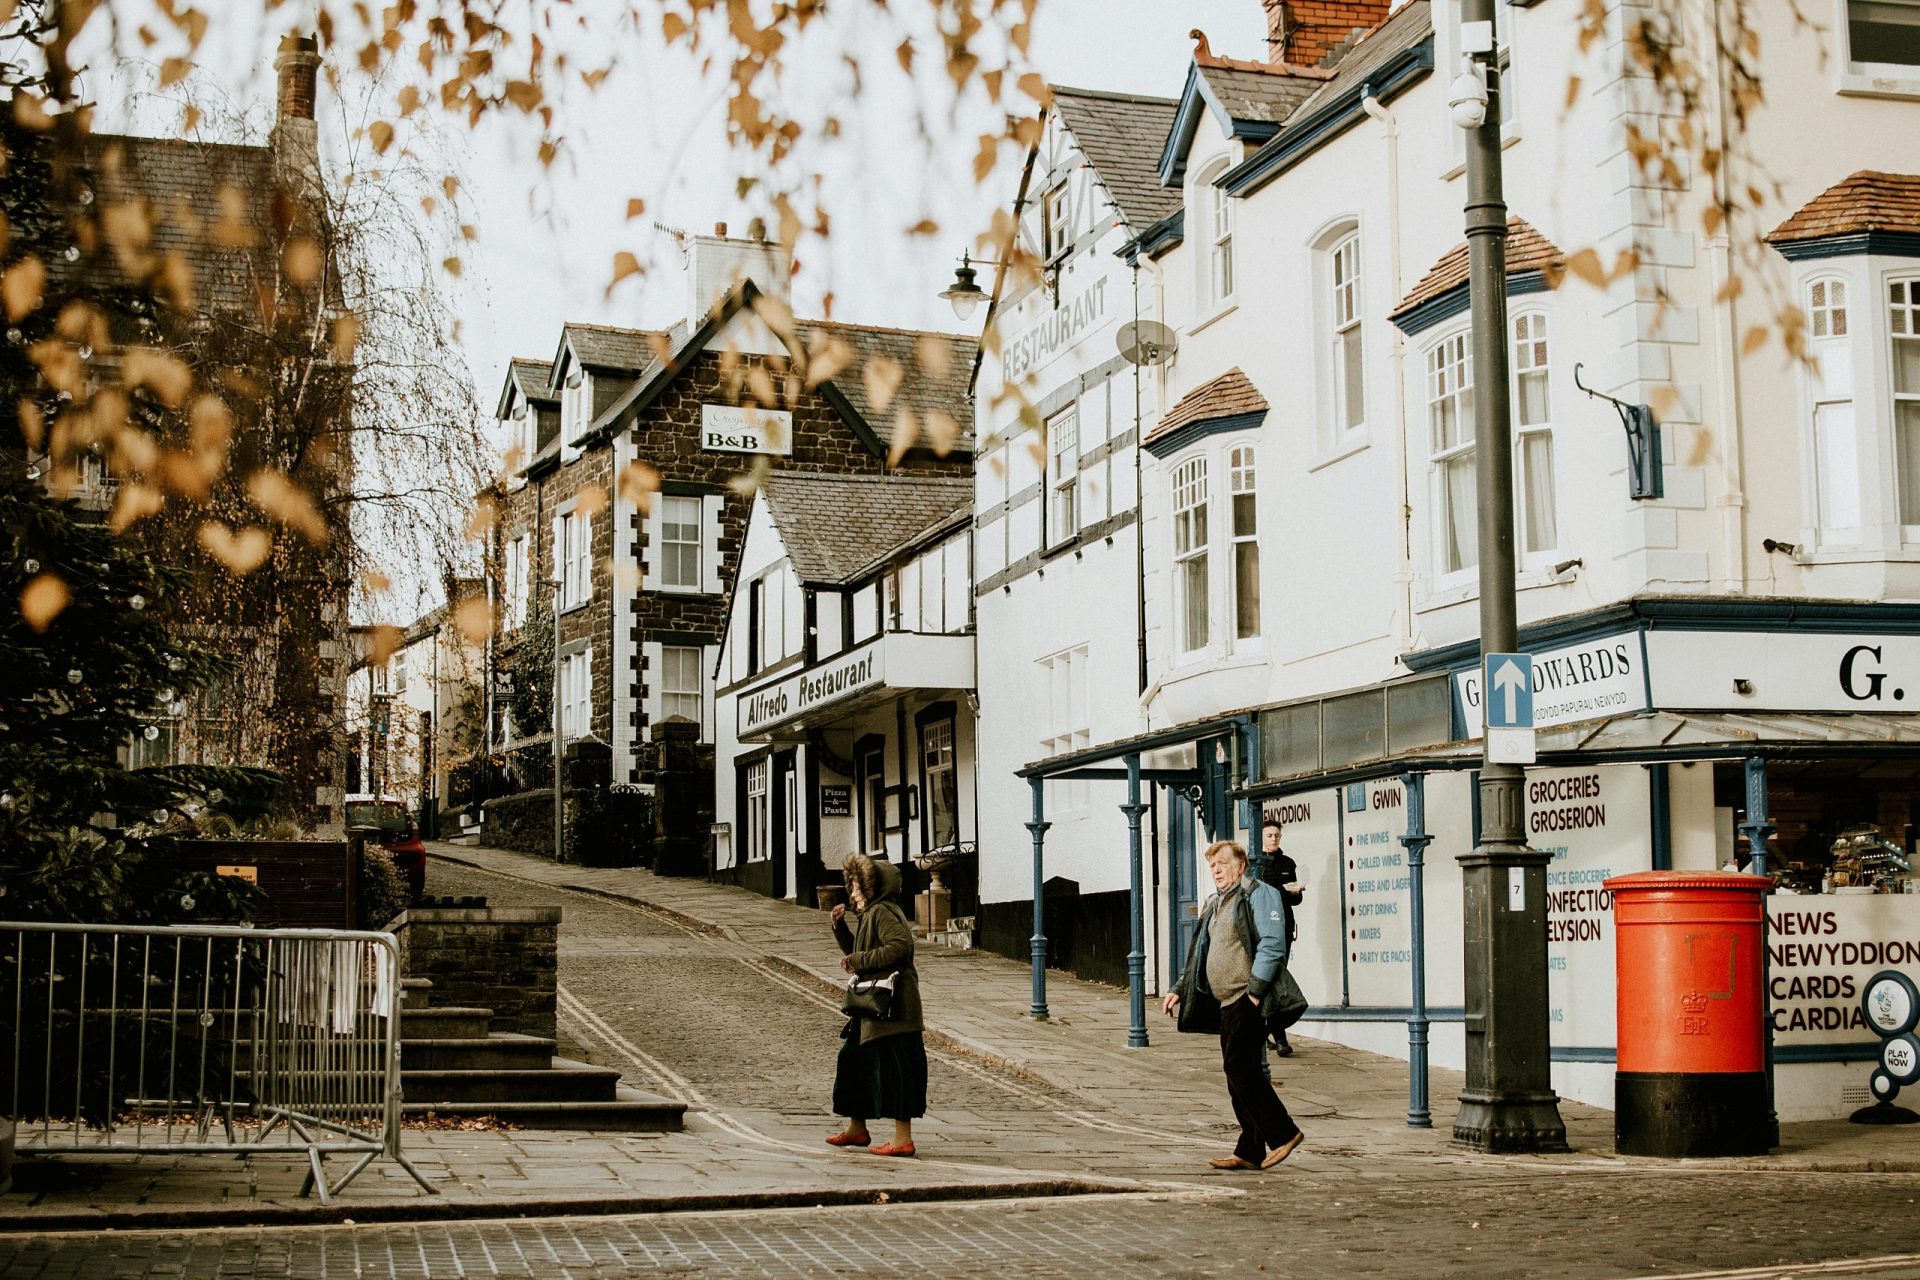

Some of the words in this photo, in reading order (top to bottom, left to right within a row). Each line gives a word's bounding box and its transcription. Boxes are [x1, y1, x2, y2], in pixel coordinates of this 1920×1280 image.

[1002, 275, 1108, 382] RESTAURANT
[707, 432, 758, 449] B&B
[1533, 644, 1630, 693] DWARDS
[1839, 645, 1905, 701] G.
[495, 683, 515, 694] B&B
[747, 687, 788, 727] Alfredo
[798, 649, 873, 707] Restaurant
[1560, 700, 1593, 715] PAPURAU
[1594, 692, 1627, 708] NEWYDD
[824, 788, 847, 796] Pizza
[1373, 787, 1401, 810] GWIN
[1529, 774, 1600, 804] GROCERIES
[824, 806, 848, 814] Pasta
[1264, 802, 1311, 824] EWYDDION
[1530, 804, 1606, 833] GROSERION
[1357, 834, 1369, 846] FINE
[1370, 831, 1389, 845] WINES
[1357, 856, 1380, 870] CHILLED
[1382, 854, 1402, 867] WINES
[1358, 880, 1375, 893] BEERS
[1376, 879, 1390, 891] AND
[1392, 877, 1410, 890] LAGER
[1547, 871, 1566, 886] ENCE
[1568, 869, 1611, 885] GROCERIES
[1513, 884, 1520, 895] 7
[1359, 904, 1374, 917] SOFT
[1375, 902, 1397, 915] DRINKS
[1547, 919, 1601, 942] ELYSION
[1767, 912, 1838, 936] NEWS
[1359, 928, 1381, 940] MIXERS
[1359, 951, 1378, 963] PARTY
[1380, 950, 1390, 963] ICE
[1391, 950, 1410, 962] PACKS
[1768, 941, 1920, 967] NEWYDDION
[1770, 975, 1856, 1000] CARDS
[1773, 1006, 1868, 1032] CARDIA
[1888, 1049, 1909, 1059] PLAY
[1888, 1058, 1908, 1067] NOW
